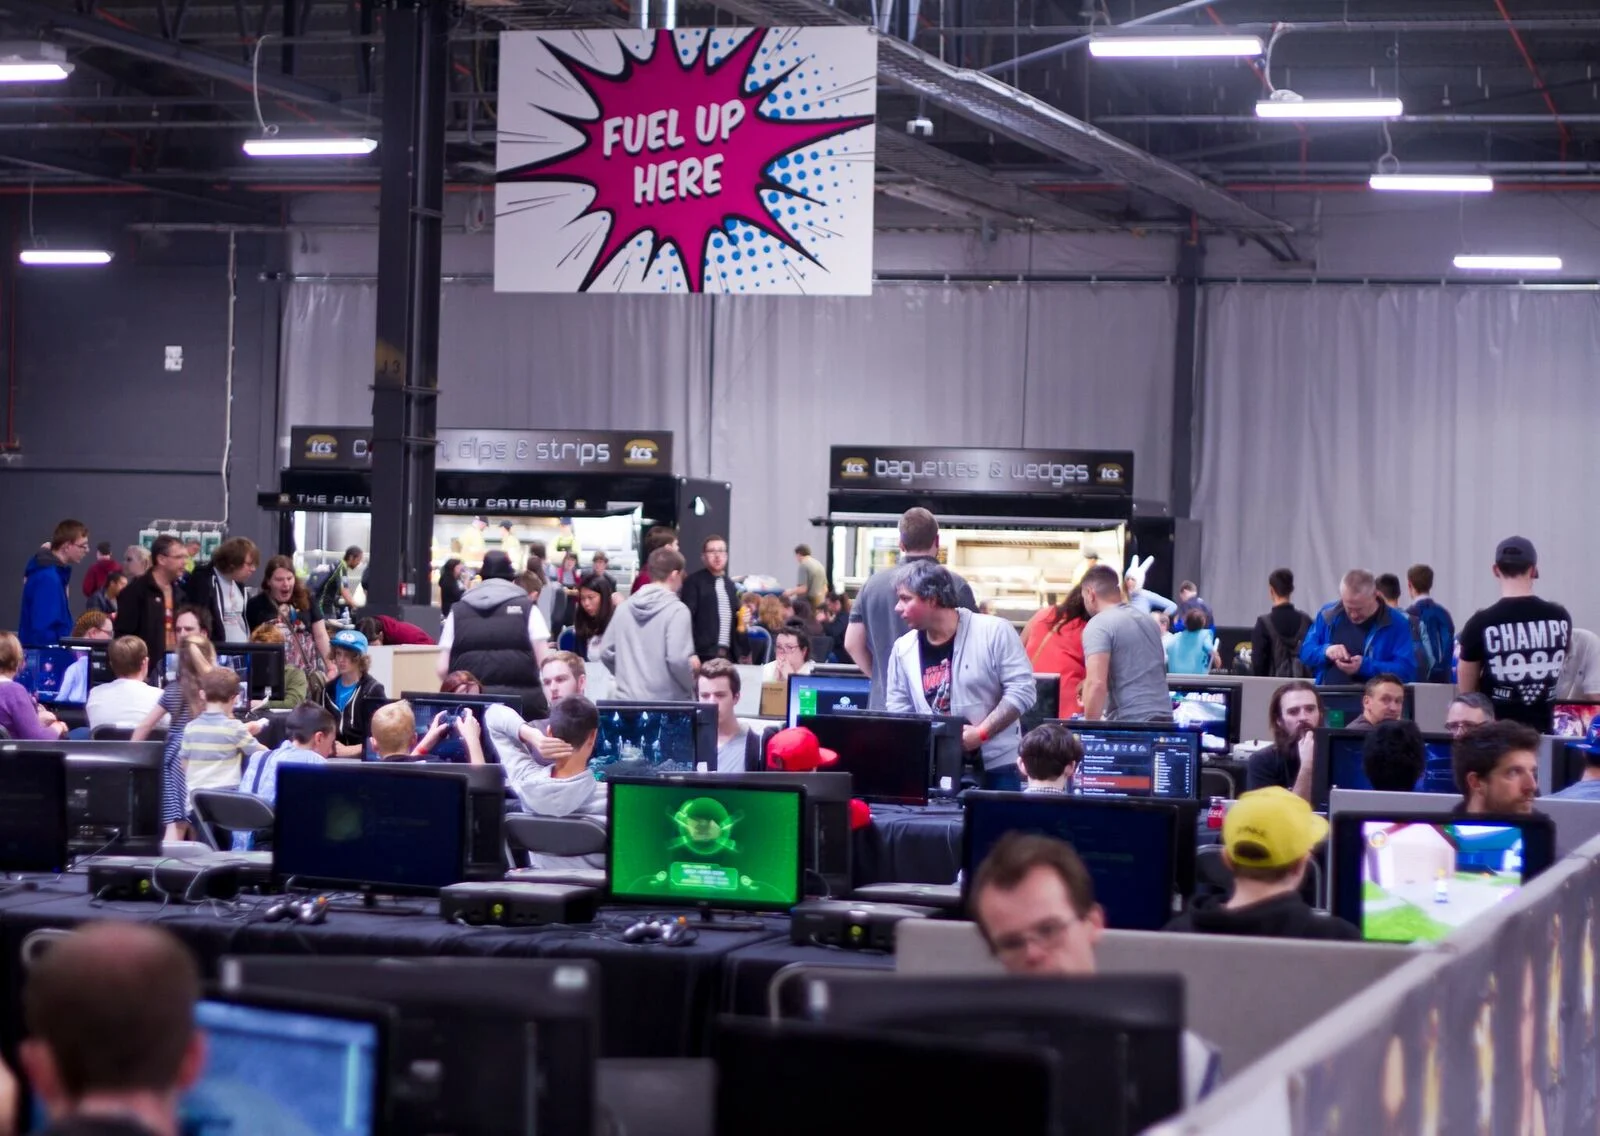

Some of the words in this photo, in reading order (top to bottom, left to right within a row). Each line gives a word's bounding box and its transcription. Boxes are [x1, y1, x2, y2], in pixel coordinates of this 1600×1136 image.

[603, 108, 685, 157] FUEL
[695, 99, 745, 143] UP
[633, 153, 724, 204] HERE
[311, 439, 332, 454] tcs
[536, 437, 610, 467] strips
[630, 445, 653, 460] tcs
[846, 462, 864, 473] tcs
[875, 457, 980, 483] baguettes
[1010, 461, 1089, 487] wedges
[1101, 467, 1120, 479] tcs
[297, 494, 327, 504] THE
[436, 497, 479, 507] VENT
[485, 498, 567, 510] CATERING
[1485, 619, 1568, 654] CHAMPS
